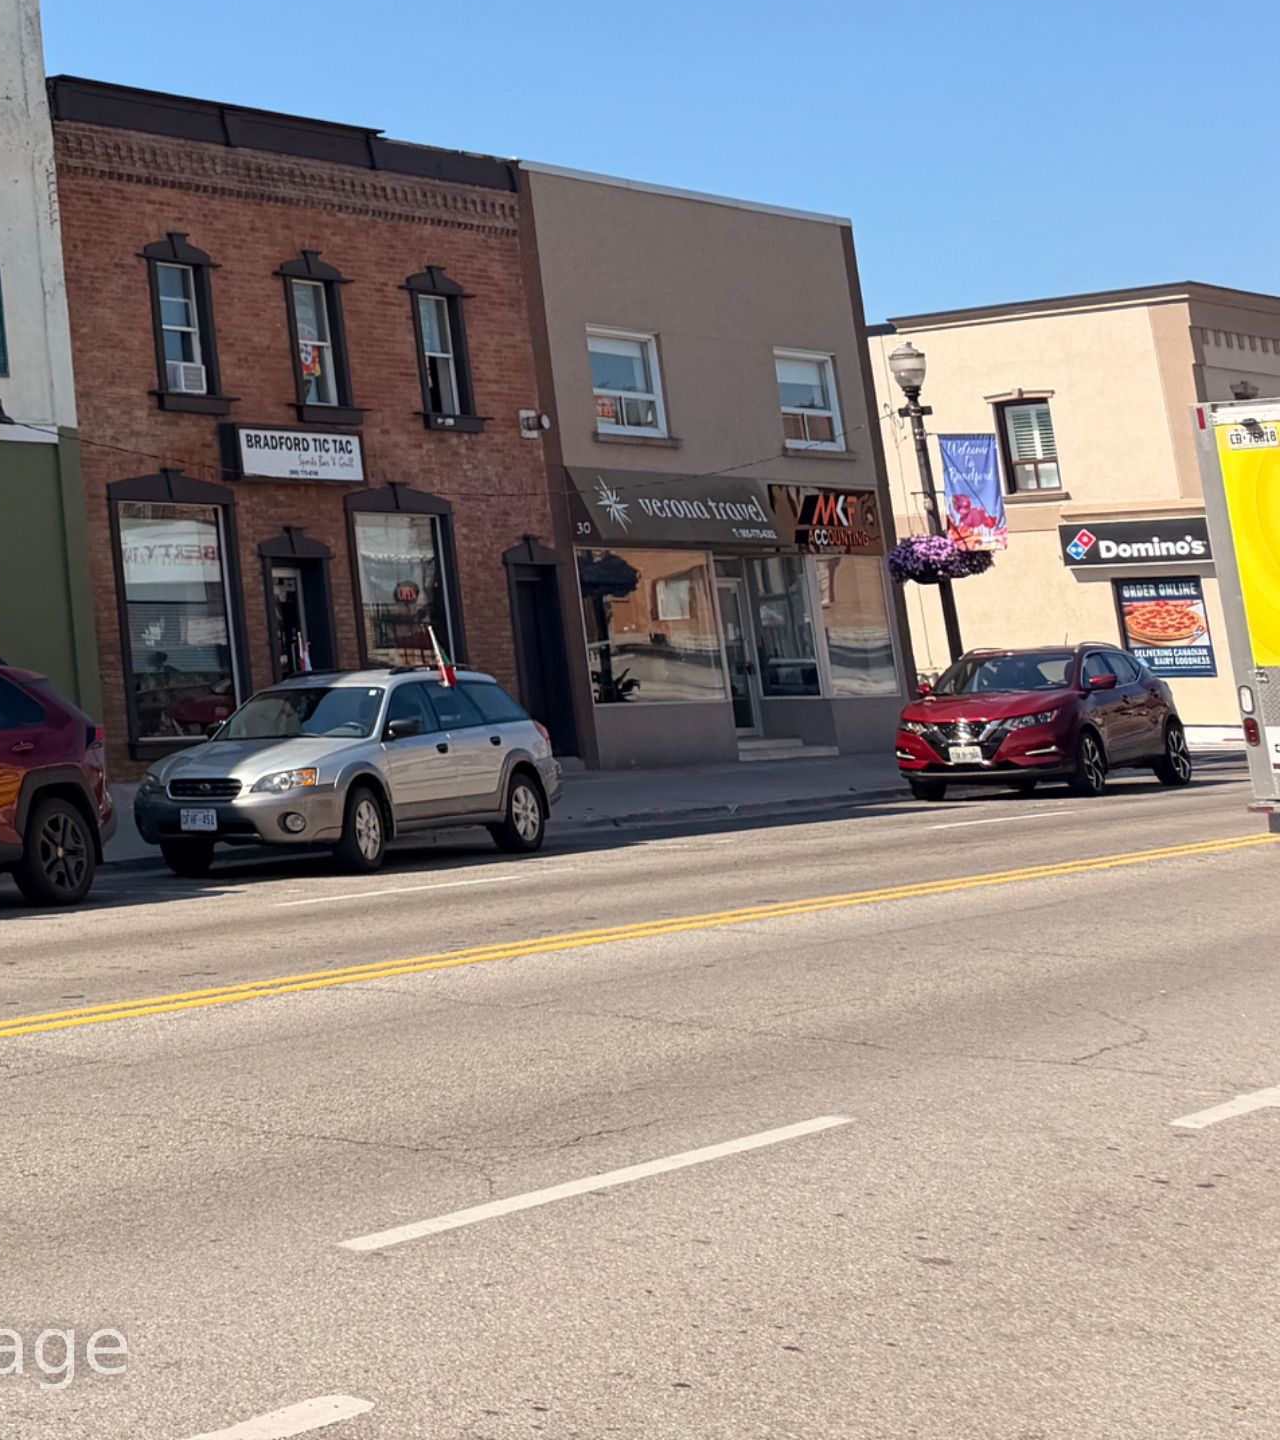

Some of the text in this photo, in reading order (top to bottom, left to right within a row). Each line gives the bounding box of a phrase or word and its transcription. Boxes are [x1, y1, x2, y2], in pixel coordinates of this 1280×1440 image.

[245, 433, 353, 455] BRADFORD TIC TAC
[638, 495, 768, 522] verona travel
[576, 522, 590, 535] 30
[809, 528, 870, 546] ACCOUNTING
[1098, 535, 1206, 559] Domino's
[1122, 582, 1197, 598] ORDER ONLINE
